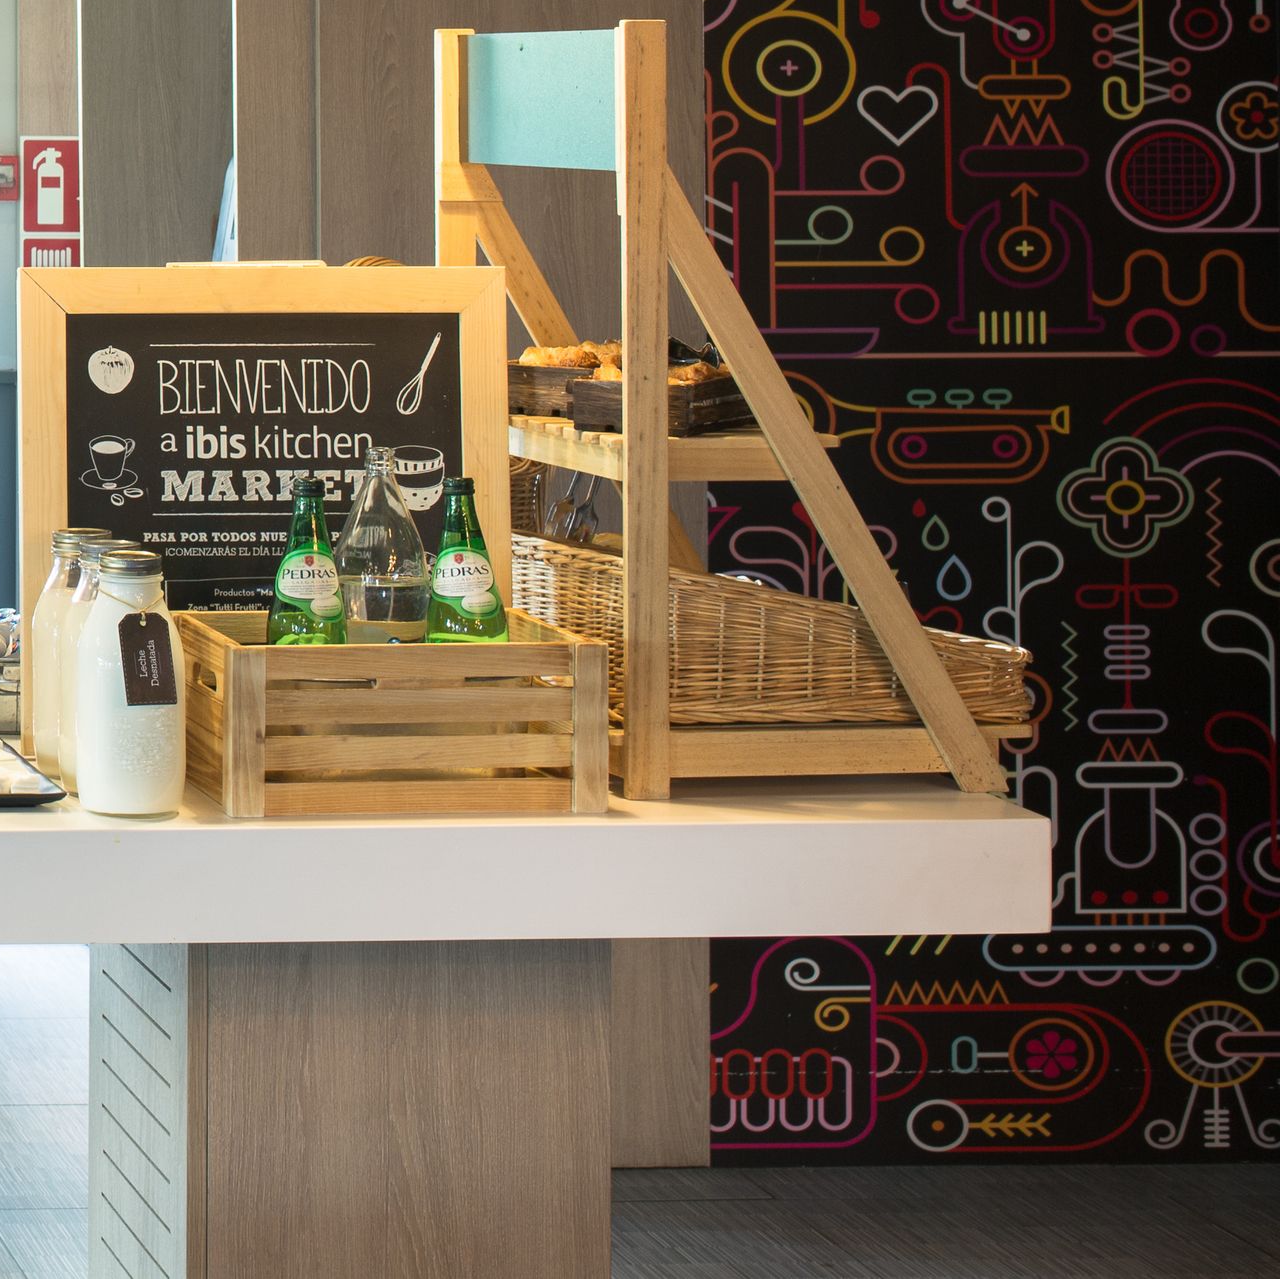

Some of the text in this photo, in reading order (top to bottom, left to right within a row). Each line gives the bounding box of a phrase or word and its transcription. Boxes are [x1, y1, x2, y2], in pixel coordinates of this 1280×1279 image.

[157, 359, 371, 415] BIENVENIDO
[160, 425, 373, 459] a ibis kitchen
[160, 469, 370, 502] MARKET
[143, 531, 288, 543] PASA POR TODOS NUE
[238, 547, 251, 557] EL
[252, 545, 270, 557] DÍA
[282, 567, 336, 580] PEDRAS
[435, 564, 489, 580] PEDRAS
[214, 588, 255, 597] Productos
[188, 603, 208, 611] Zona
[137, 649, 148, 678] Leche
[146, 640, 160, 687] Desnatada
